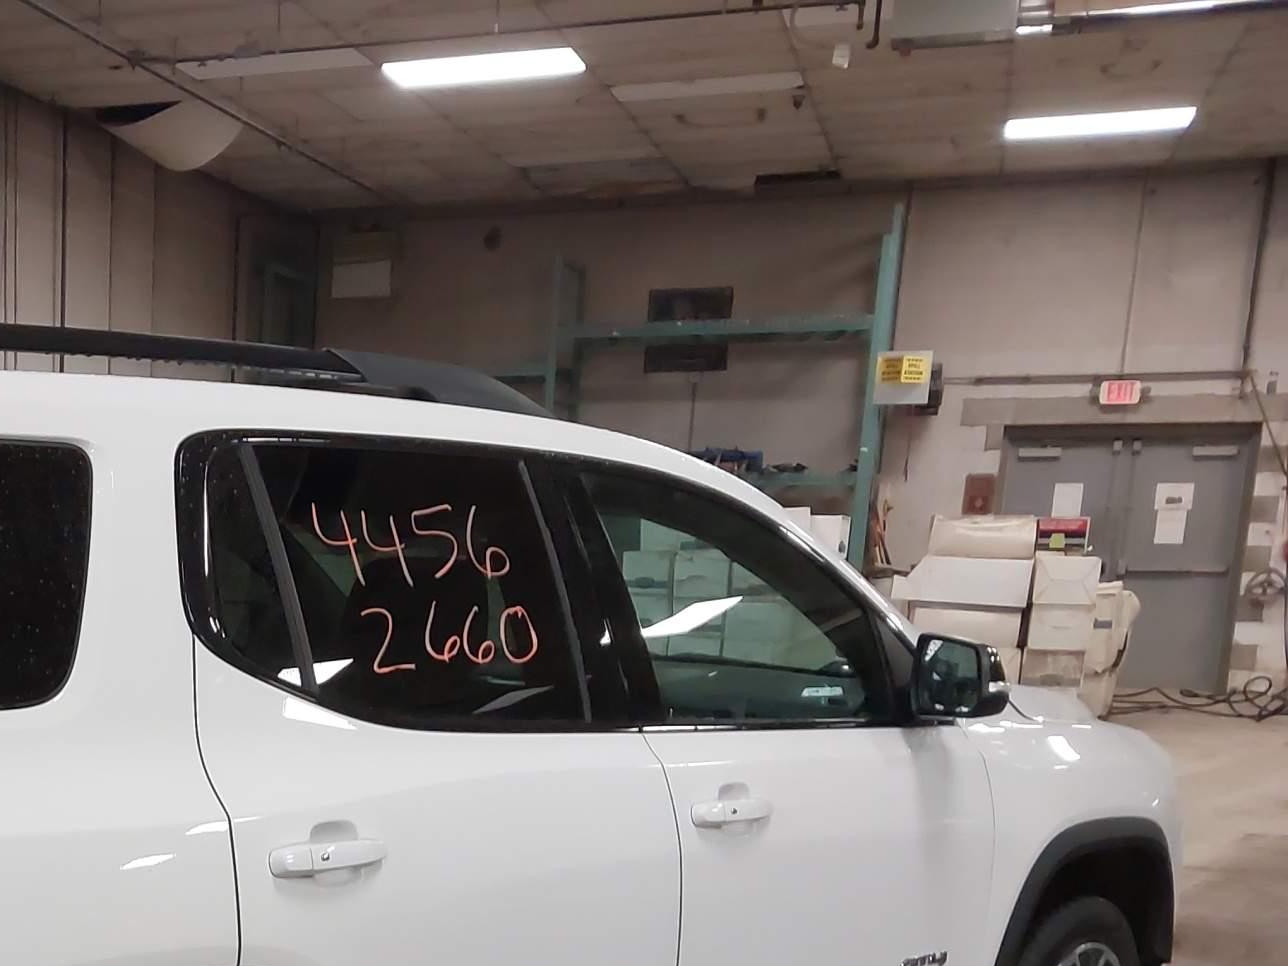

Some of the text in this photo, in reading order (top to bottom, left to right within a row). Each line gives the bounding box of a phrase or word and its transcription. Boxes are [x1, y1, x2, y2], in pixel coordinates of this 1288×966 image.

[1106, 382, 1136, 402] EXIT
[312, 501, 511, 587] 4456
[360, 600, 539, 675] 2660
